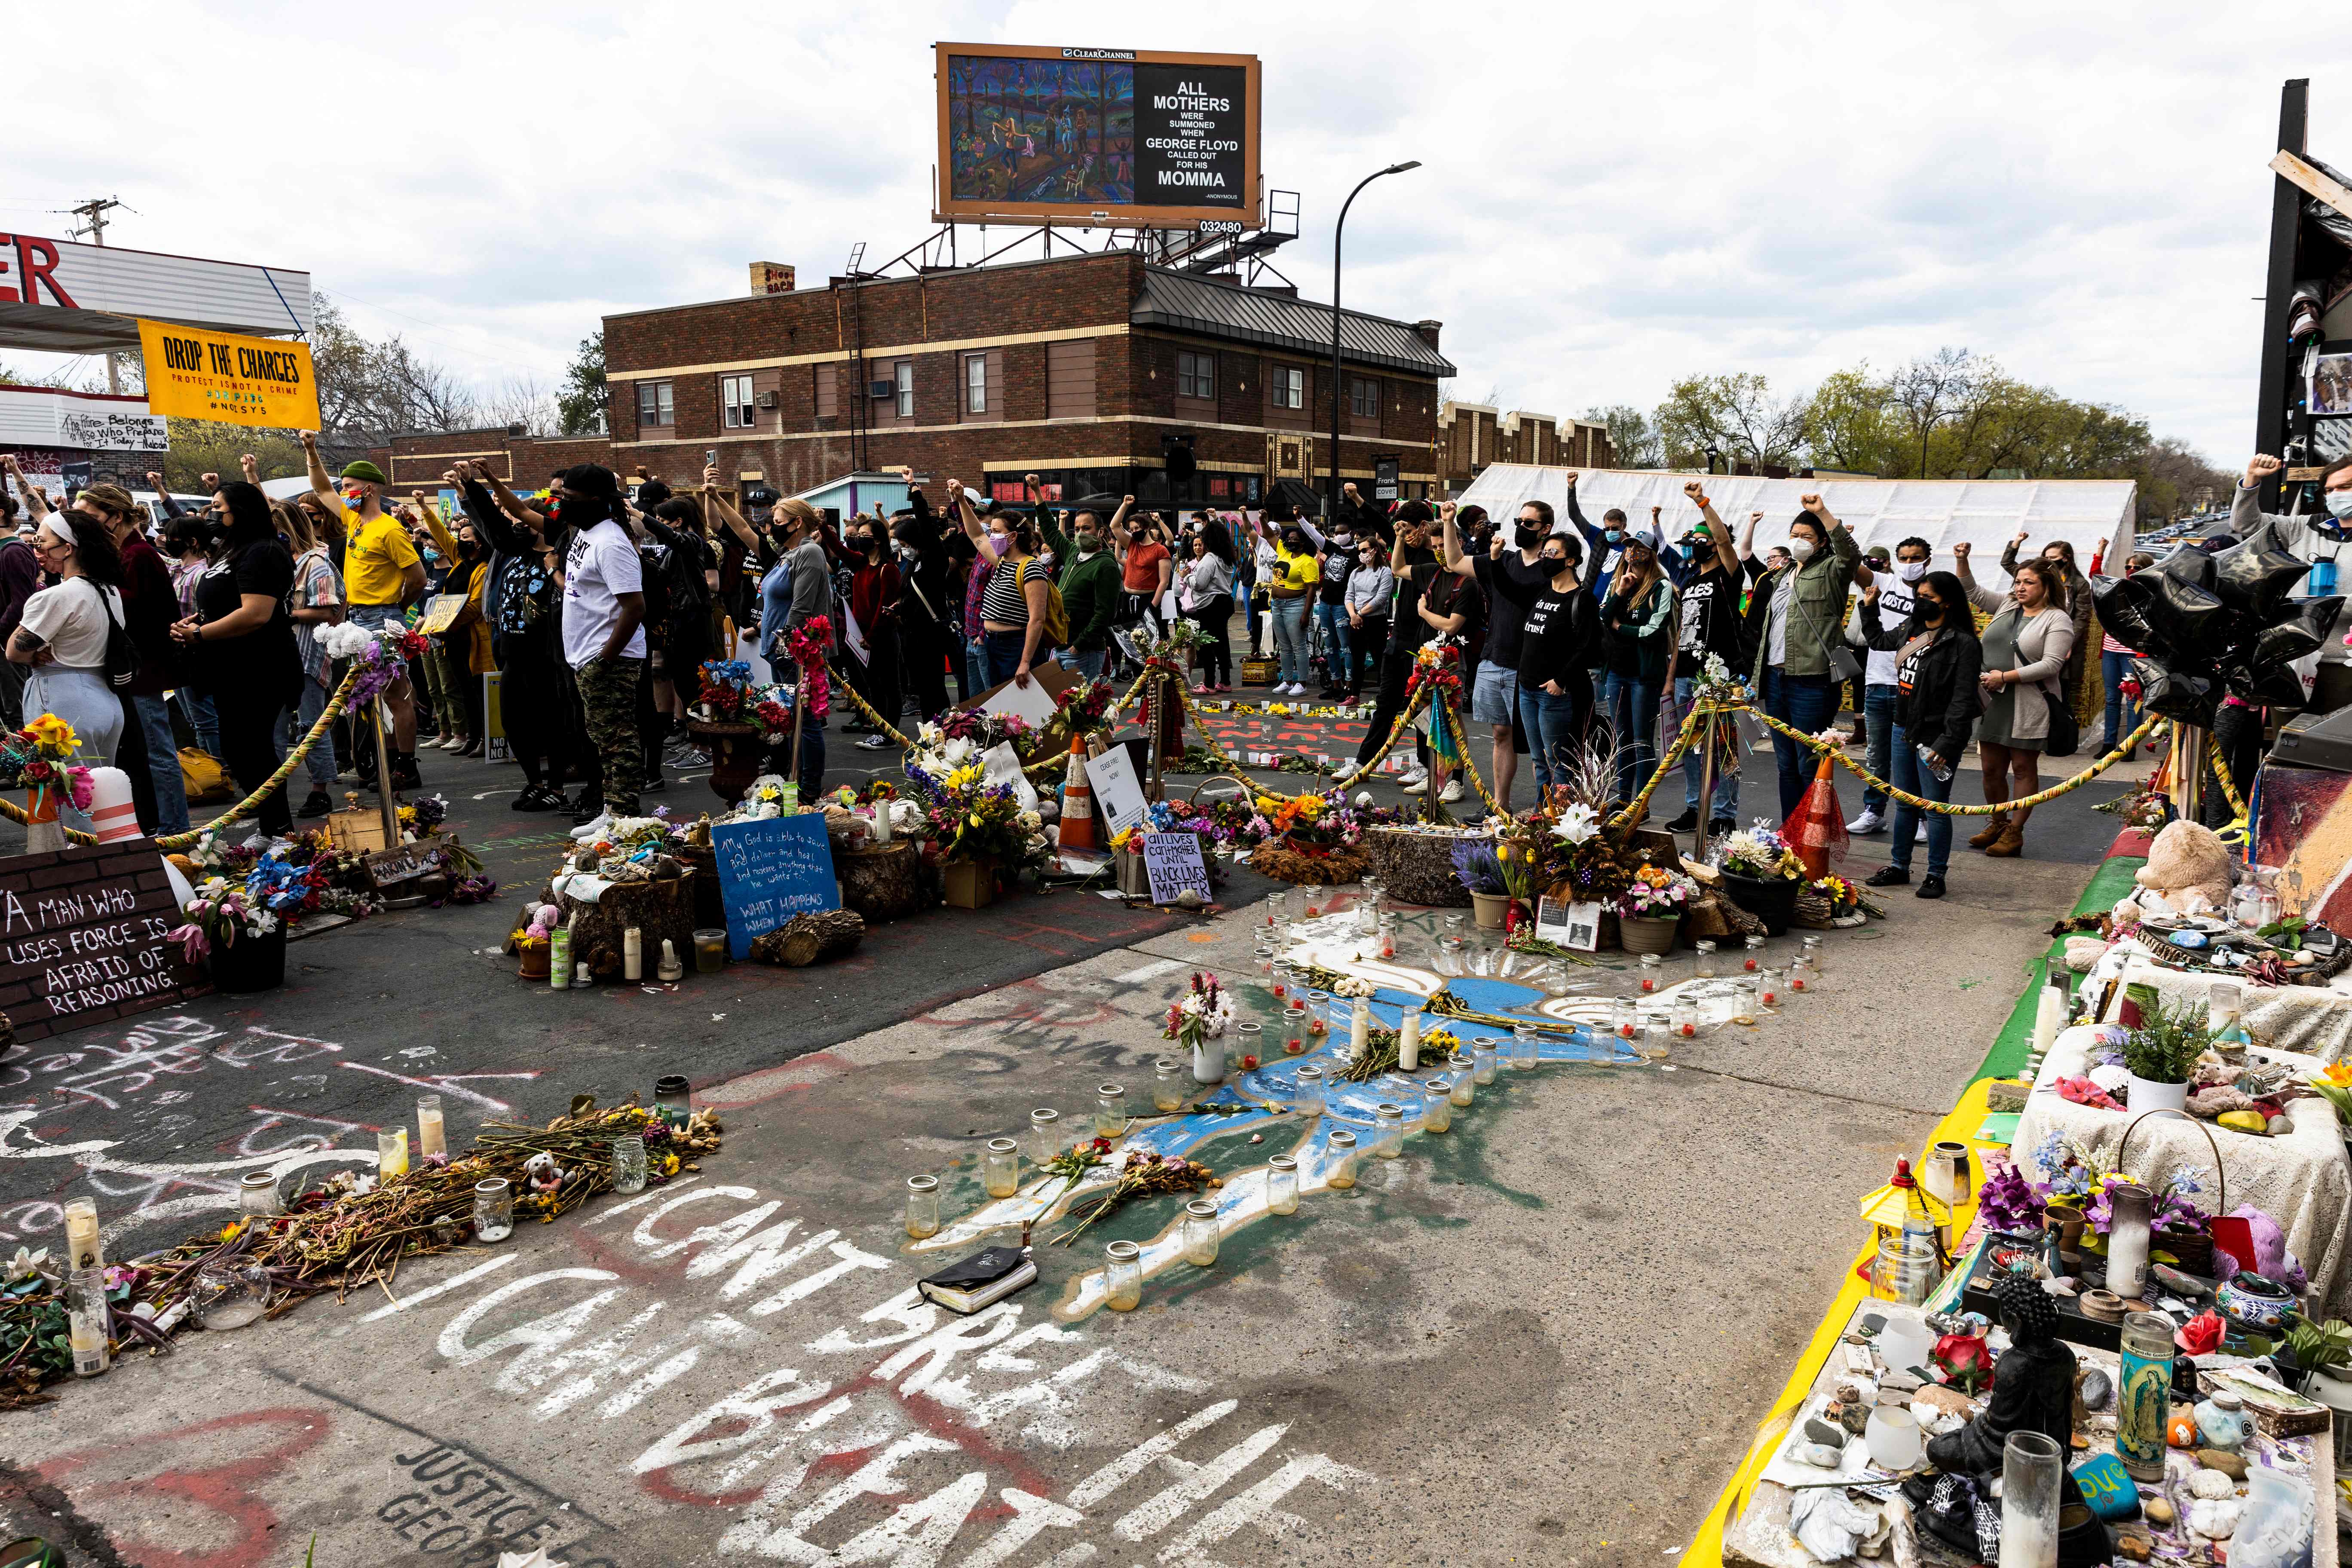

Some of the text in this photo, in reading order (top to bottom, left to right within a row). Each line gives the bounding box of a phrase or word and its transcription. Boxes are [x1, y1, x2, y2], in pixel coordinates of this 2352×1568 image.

[1177, 82, 1207, 95] ALL
[1154, 96, 1230, 111] MOTHERS
[1170, 120, 1215, 129] SUMMONED
[1146, 138, 1238, 151] GEORGE FLOYD
[1158, 171, 1225, 187] MOMMA
[1200, 221, 1241, 233] 032480
[766, 268, 795, 282] SHOOT
[767, 281, 795, 294] BACK
[163, 337, 300, 383] DROP THE CHARGES
[172, 374, 213, 386] PROTEST
[270, 386, 297, 395] CRIME
[62, 414, 154, 433] The Future Belongs
[97, 427, 123, 438] Who
[126, 426, 165, 438] Prepare
[95, 439, 108, 448] It
[111, 437, 135, 450] Today
[14, 452, 60, 463] BLACK
[1536, 599, 1561, 612] in art
[1881, 594, 1905, 610] JUST
[1534, 612, 1547, 622] we
[1525, 621, 1545, 634] trust
[493, 737, 505, 748] NO
[490, 748, 503, 759] NO
[1100, 761, 1112, 771] CEASE
[1109, 770, 1121, 781] NOW!
[721, 830, 826, 860] My God is able to save
[730, 848, 815, 869] and deliver and heal
[1161, 854, 1188, 865] UNTIL
[736, 860, 824, 882] and restore anything that
[1151, 867, 1183, 883] BLACK
[751, 880, 763, 889] he
[768, 871, 790, 883] wants
[1156, 880, 1211, 901] MATTER
[38, 894, 84, 928] MAN
[88, 888, 135, 916] WHO
[739, 899, 773, 918] WHAT
[779, 893, 823, 912] HAPPENS
[745, 917, 775, 932] WHEN
[7, 918, 168, 964] USES FORCE IS
[46, 946, 165, 992] AFRAID OF
[2129, 1344, 2144, 1356] Virgen
[2119, 1455, 2128, 1463] Our
[2128, 1458, 2141, 1468] Lady
[395, 1445, 560, 1543] JUSTICE
